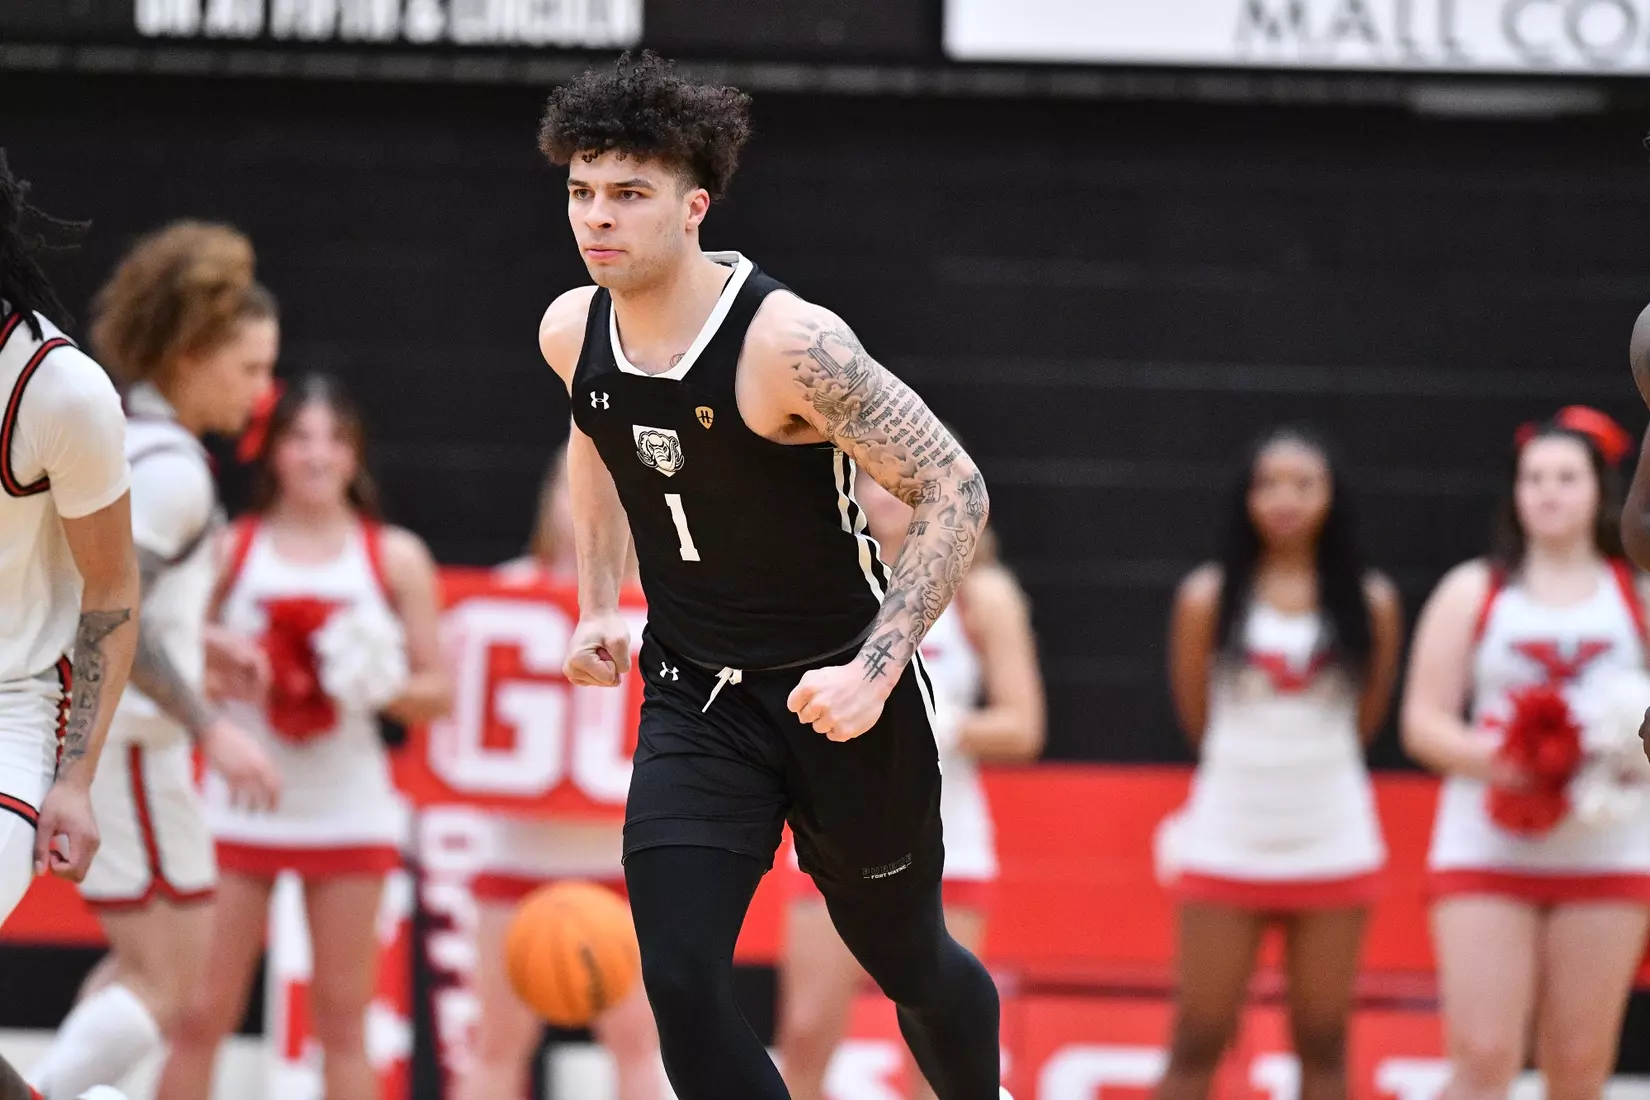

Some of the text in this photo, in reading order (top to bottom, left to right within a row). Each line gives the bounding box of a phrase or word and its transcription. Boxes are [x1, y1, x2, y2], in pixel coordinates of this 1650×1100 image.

[1233, 0, 1476, 64] MALL
[664, 493, 701, 562] 1
[871, 864, 907, 880] FORT WAYNE
